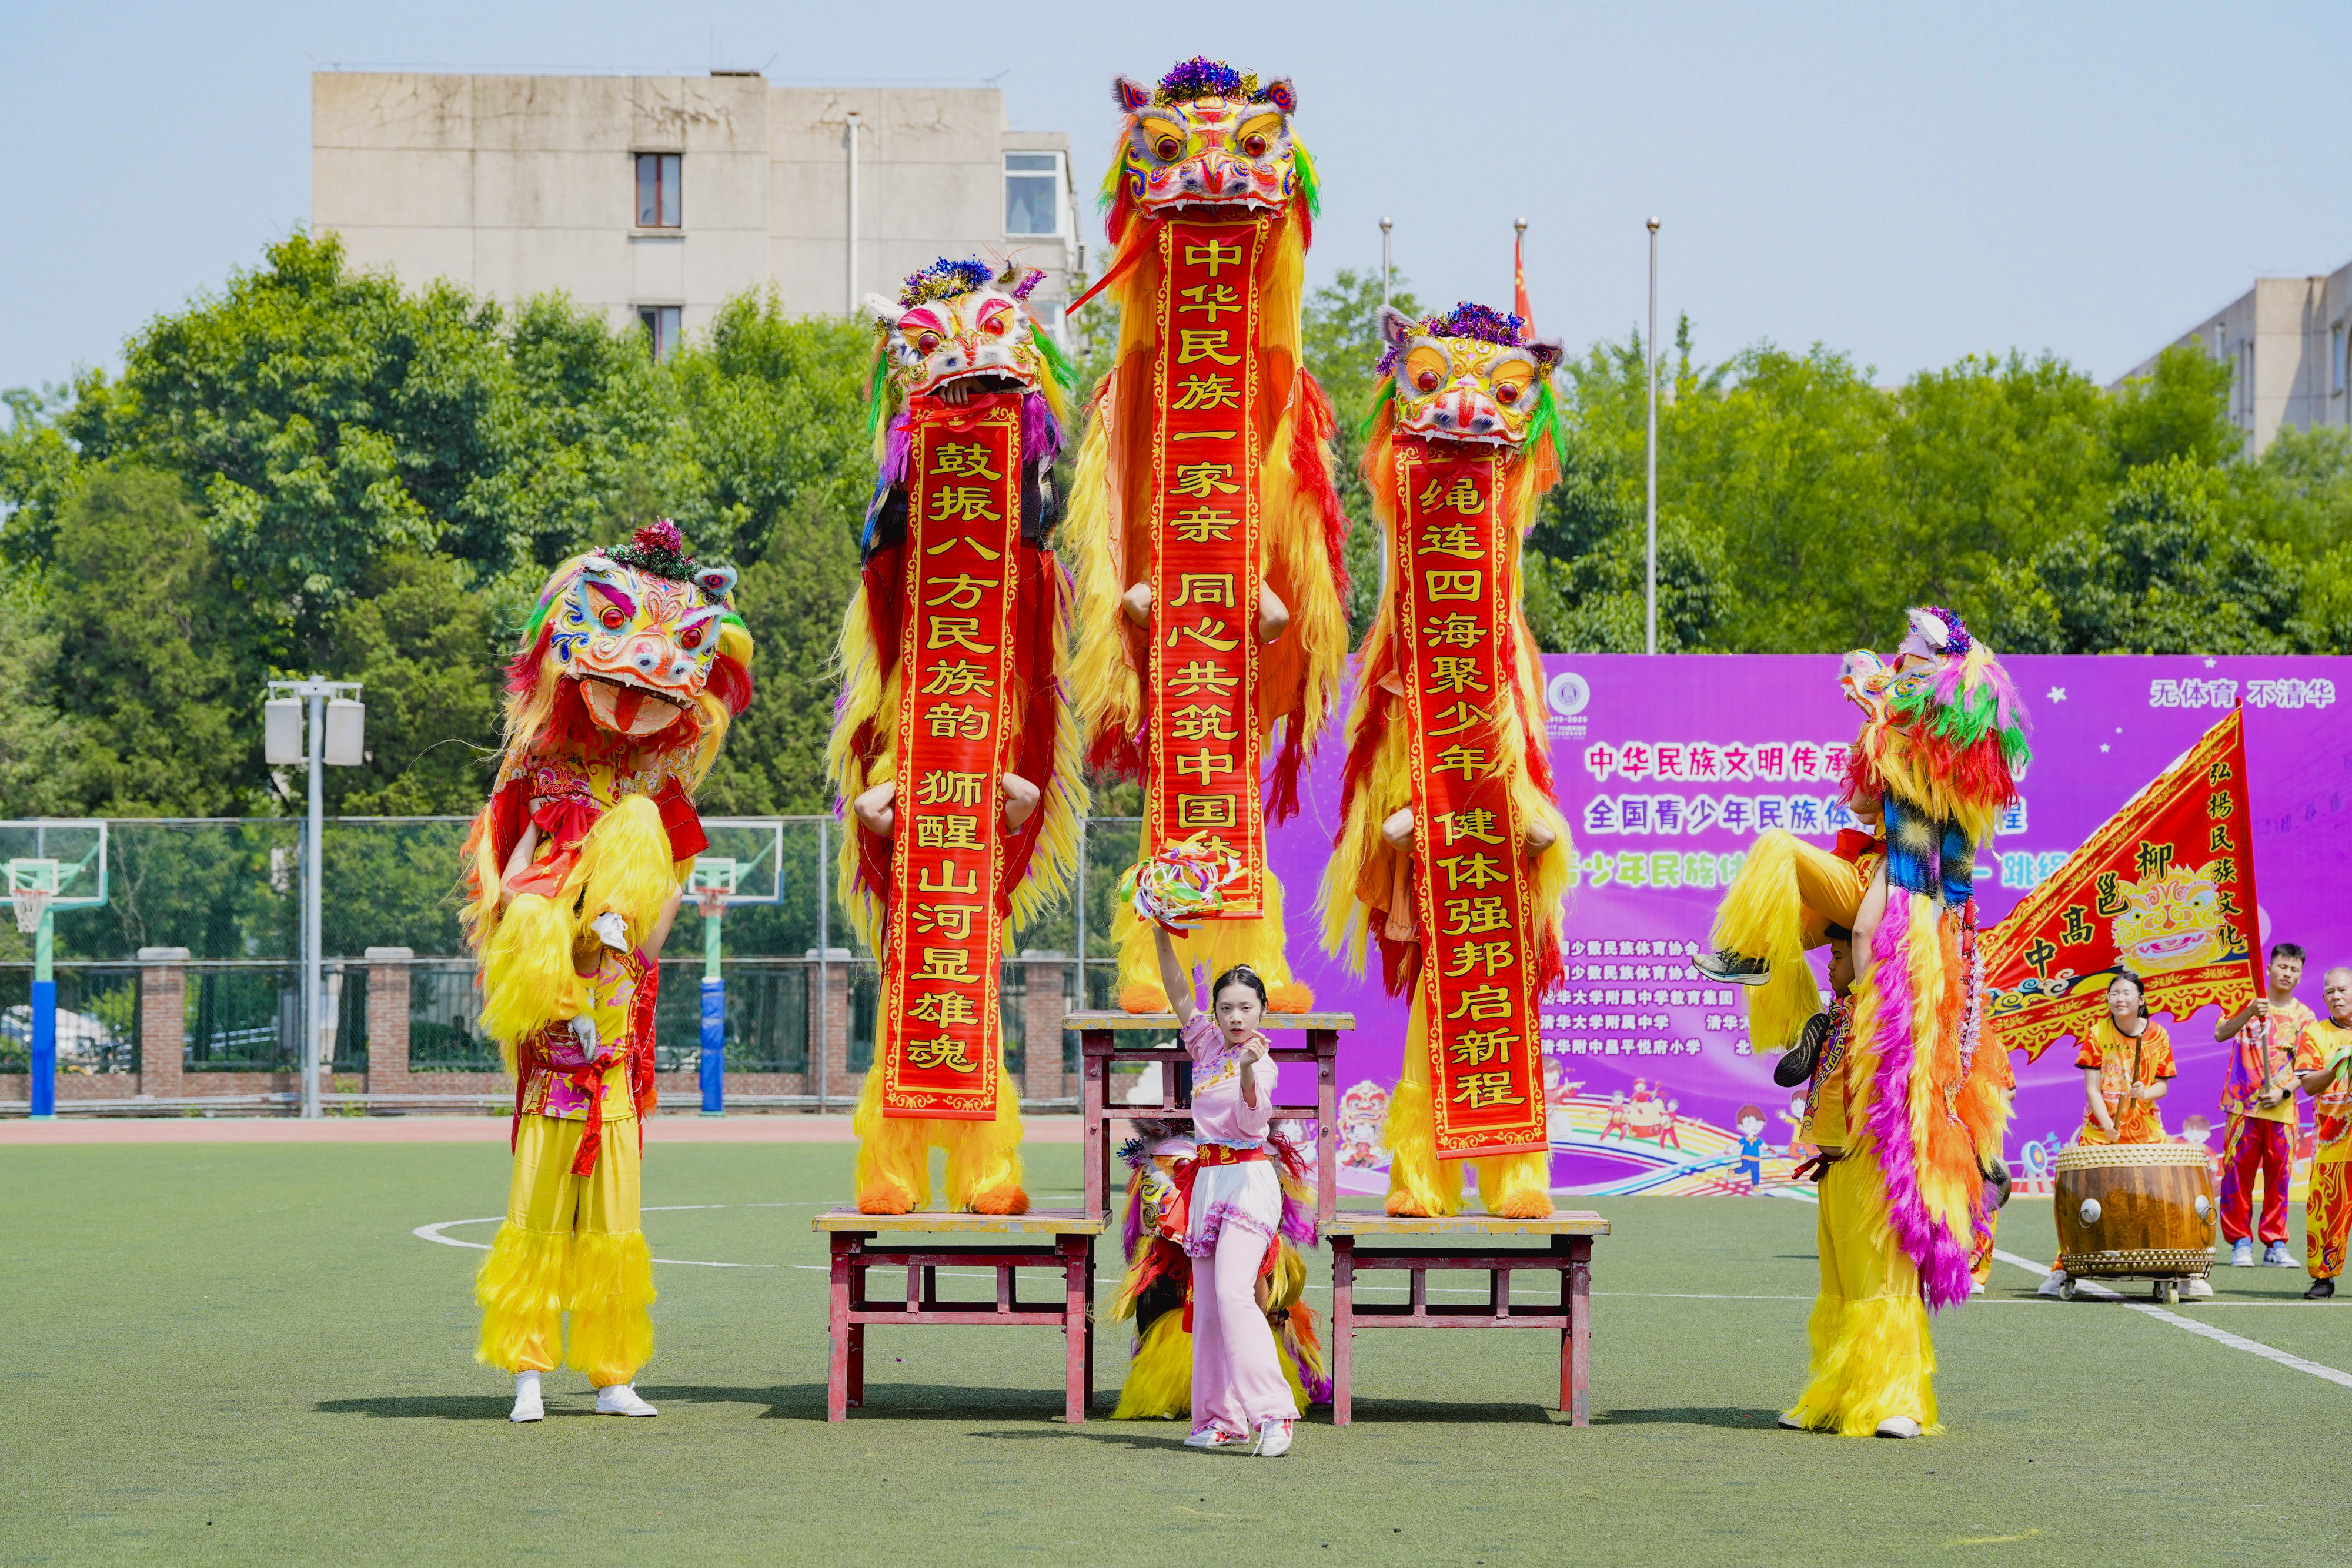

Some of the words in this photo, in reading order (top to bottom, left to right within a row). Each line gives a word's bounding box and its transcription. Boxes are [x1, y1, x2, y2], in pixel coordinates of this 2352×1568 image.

[1168, 239, 1243, 543] 中华民族一家亲
[920, 442, 1003, 741] 鼓振八方民族韵
[1417, 477, 1498, 781] 绳连四海聚少年
[1587, 744, 1848, 780] 中华民族文明传承
[2149, 678, 2238, 708] 无体育
[2246, 678, 2336, 709] 不清华
[907, 769, 988, 1073] 狮醒山河显雄魂
[1433, 807, 1526, 1109] 健体强邦启新程
[1562, 965, 1713, 981] 少数民族体育协会
[1540, 1014, 1670, 1030] 清华大学附属中学
[1541, 1039, 1701, 1055] 清华附中昌平悦府小学
